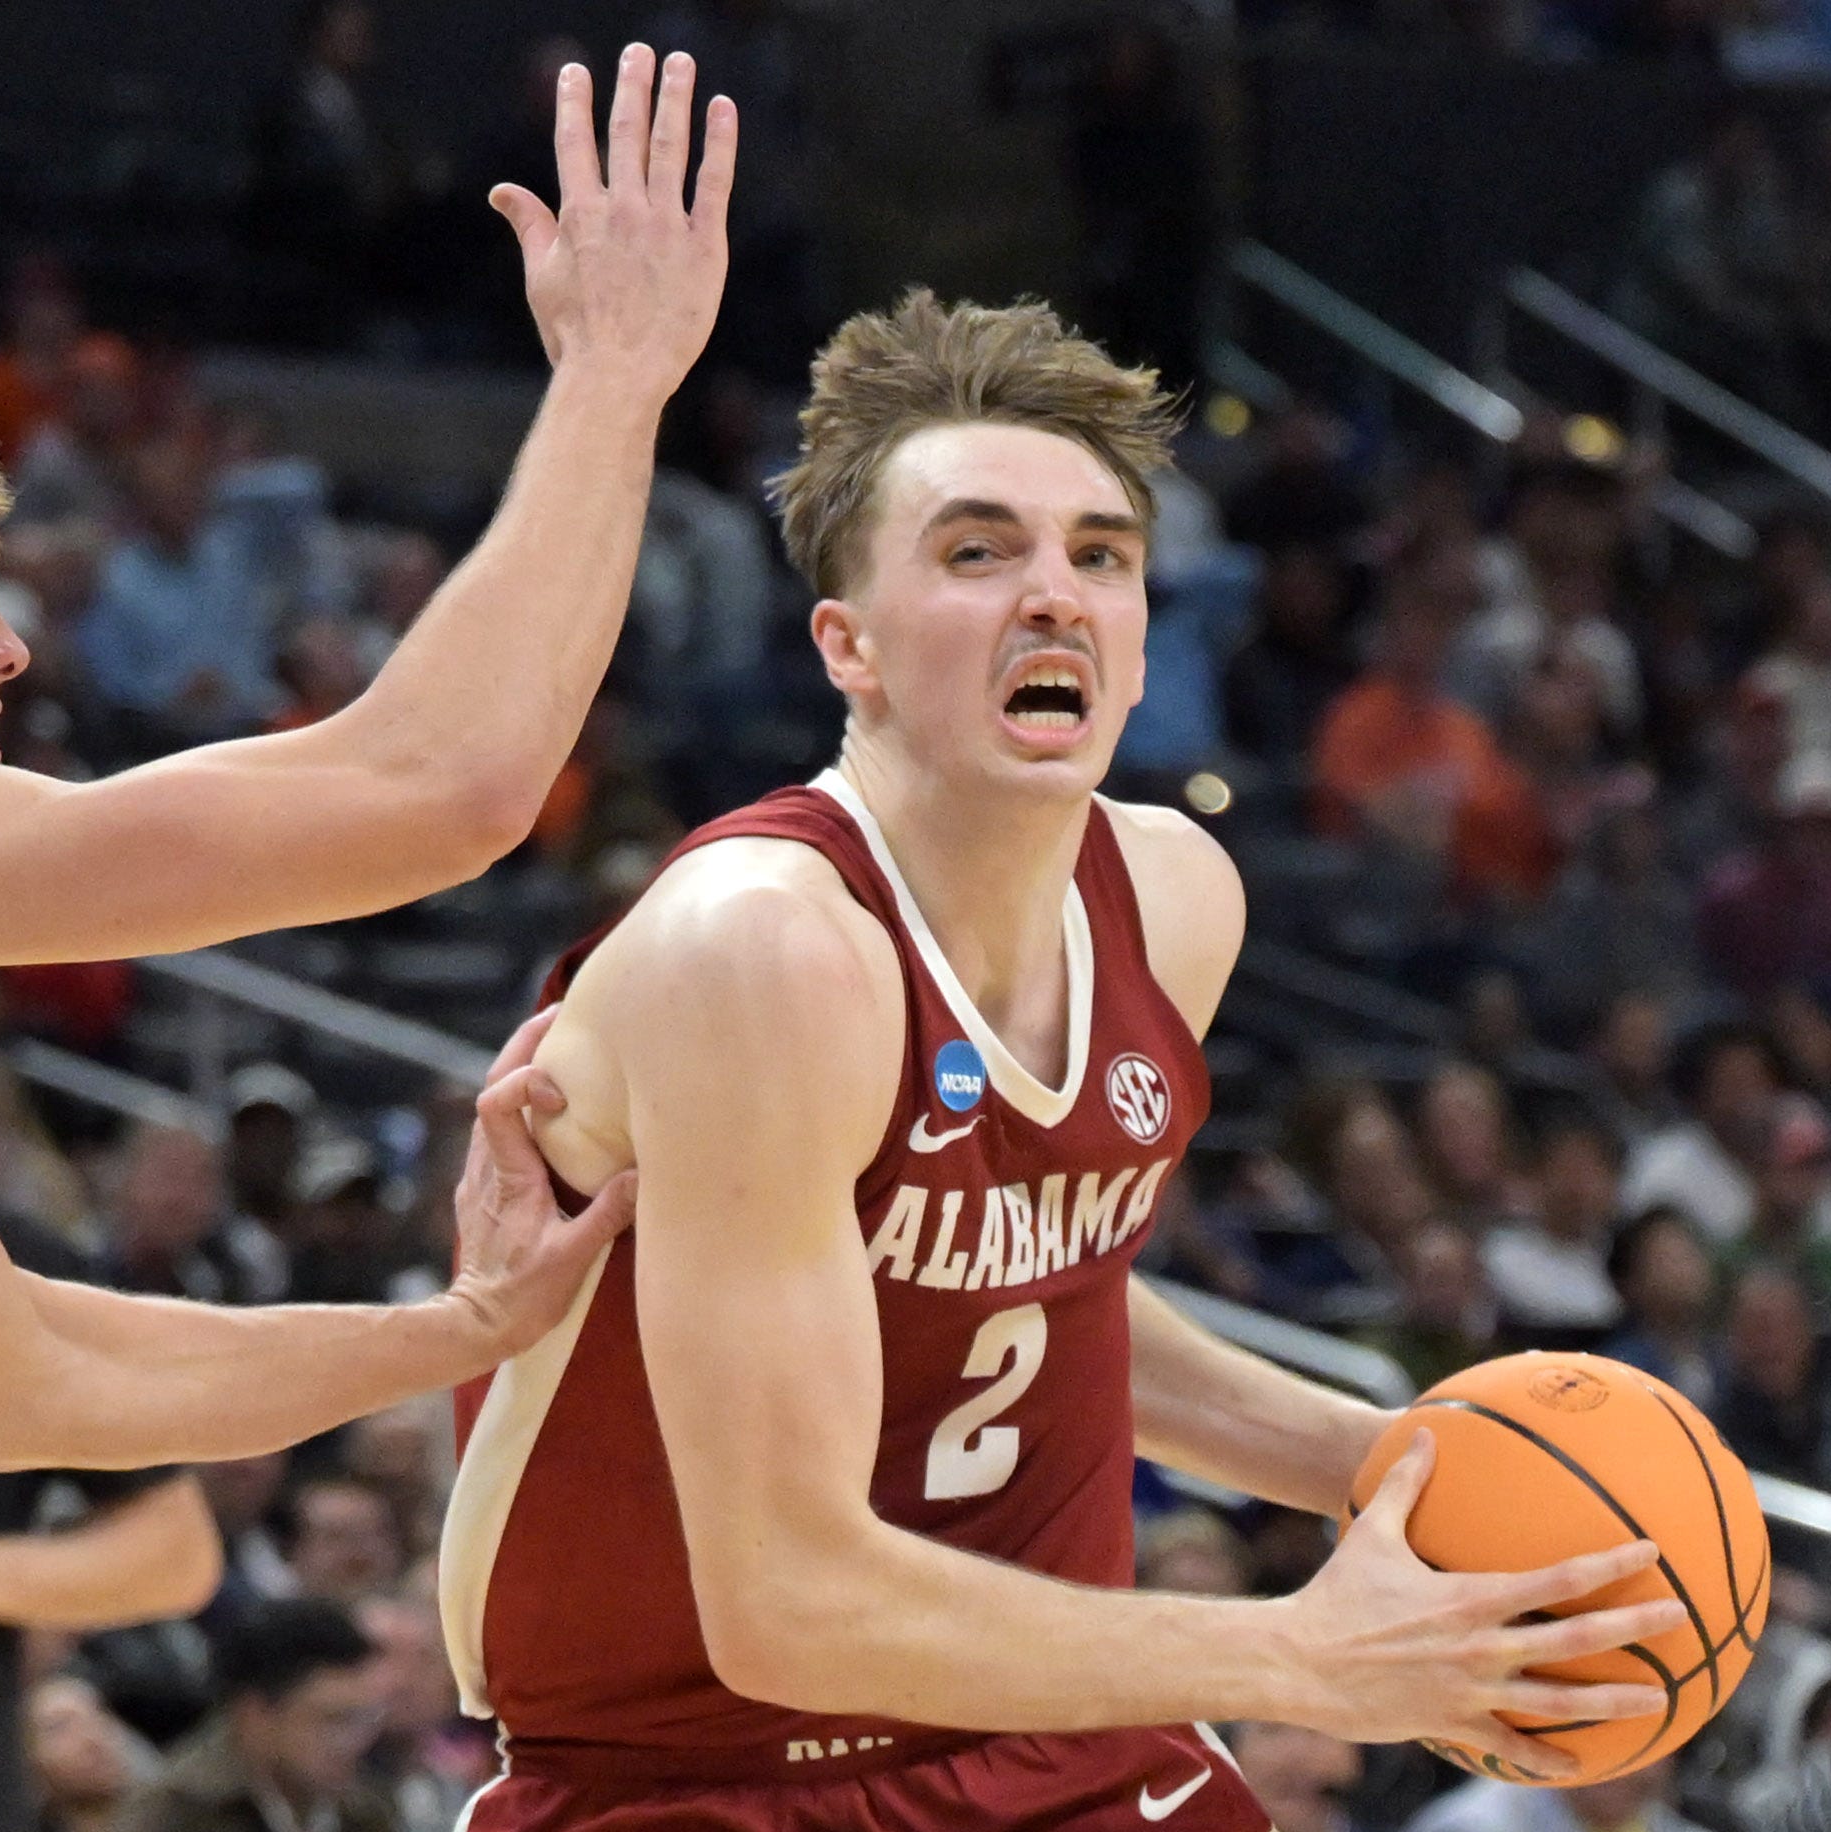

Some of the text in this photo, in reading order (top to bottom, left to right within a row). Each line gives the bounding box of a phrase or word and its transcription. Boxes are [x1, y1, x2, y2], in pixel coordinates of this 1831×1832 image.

[941, 1072, 982, 1095] NCAA
[1111, 1060, 1167, 1138] SEC
[867, 1158, 1172, 1291] ALABAMA
[924, 1301, 1048, 1502] 2
